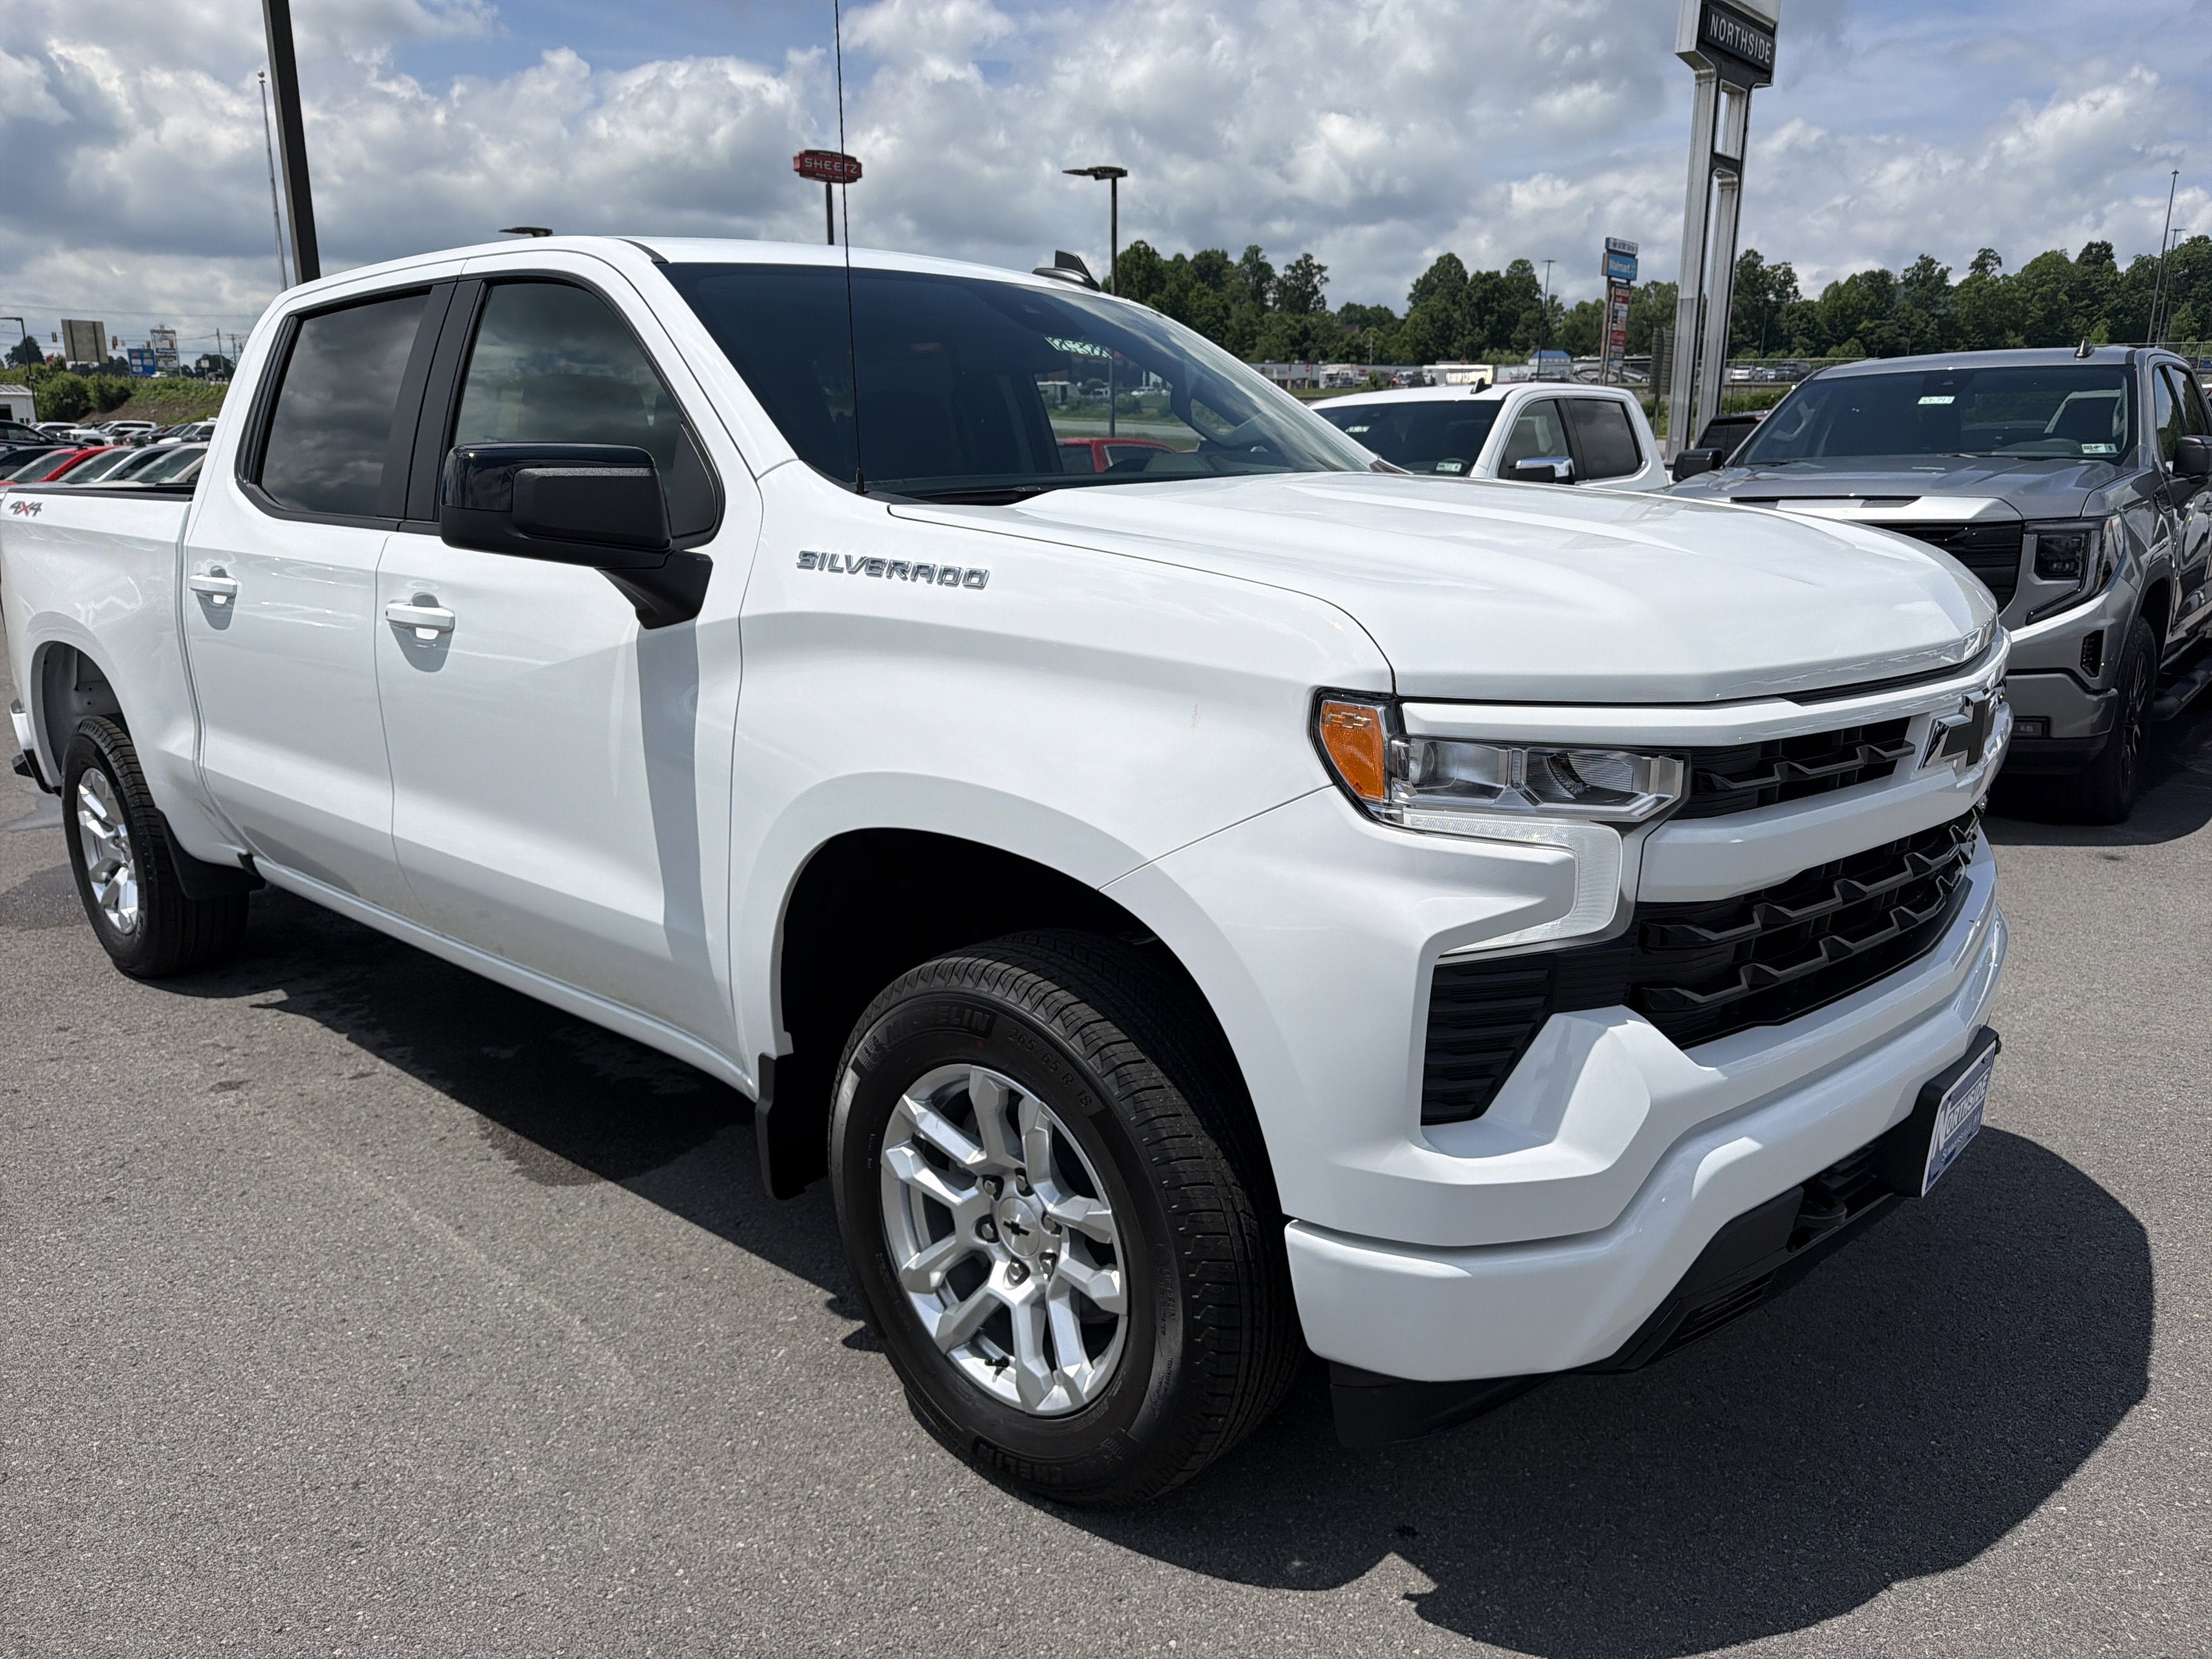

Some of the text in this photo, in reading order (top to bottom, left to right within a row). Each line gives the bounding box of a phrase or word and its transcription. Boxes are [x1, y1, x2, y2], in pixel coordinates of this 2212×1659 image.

[1709, 13, 1771, 64] NORTHSIDE
[804, 157, 857, 174] SHEETZ
[796, 550, 990, 589] SILVERADO
[884, 1005, 991, 1046] MIELIN
[1007, 1028, 1092, 1107] 265/65 R 18
[1931, 1073, 1989, 1160] NORTHSIDE
